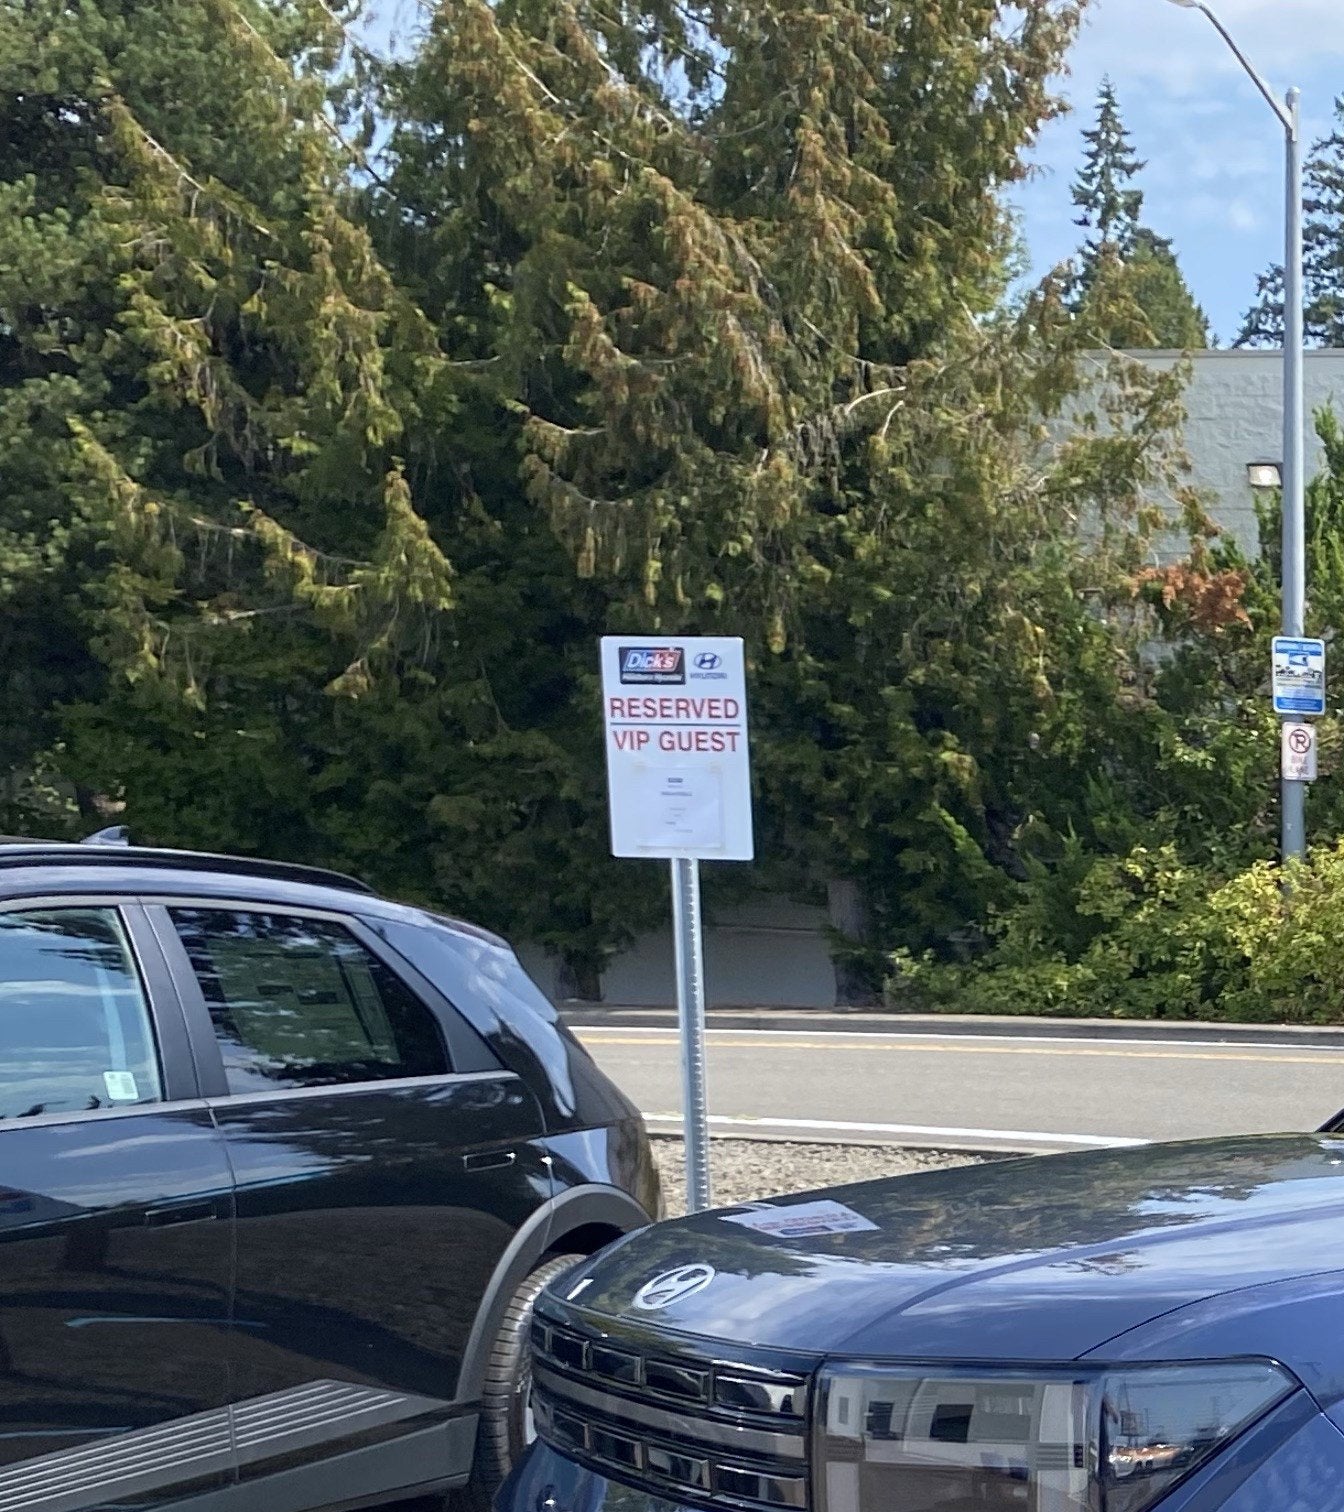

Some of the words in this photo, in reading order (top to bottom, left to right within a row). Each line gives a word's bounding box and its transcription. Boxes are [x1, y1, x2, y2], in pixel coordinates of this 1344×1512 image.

[609, 697, 740, 719] RESERVED
[613, 730, 650, 751] VIP
[659, 730, 741, 752] GUEST
